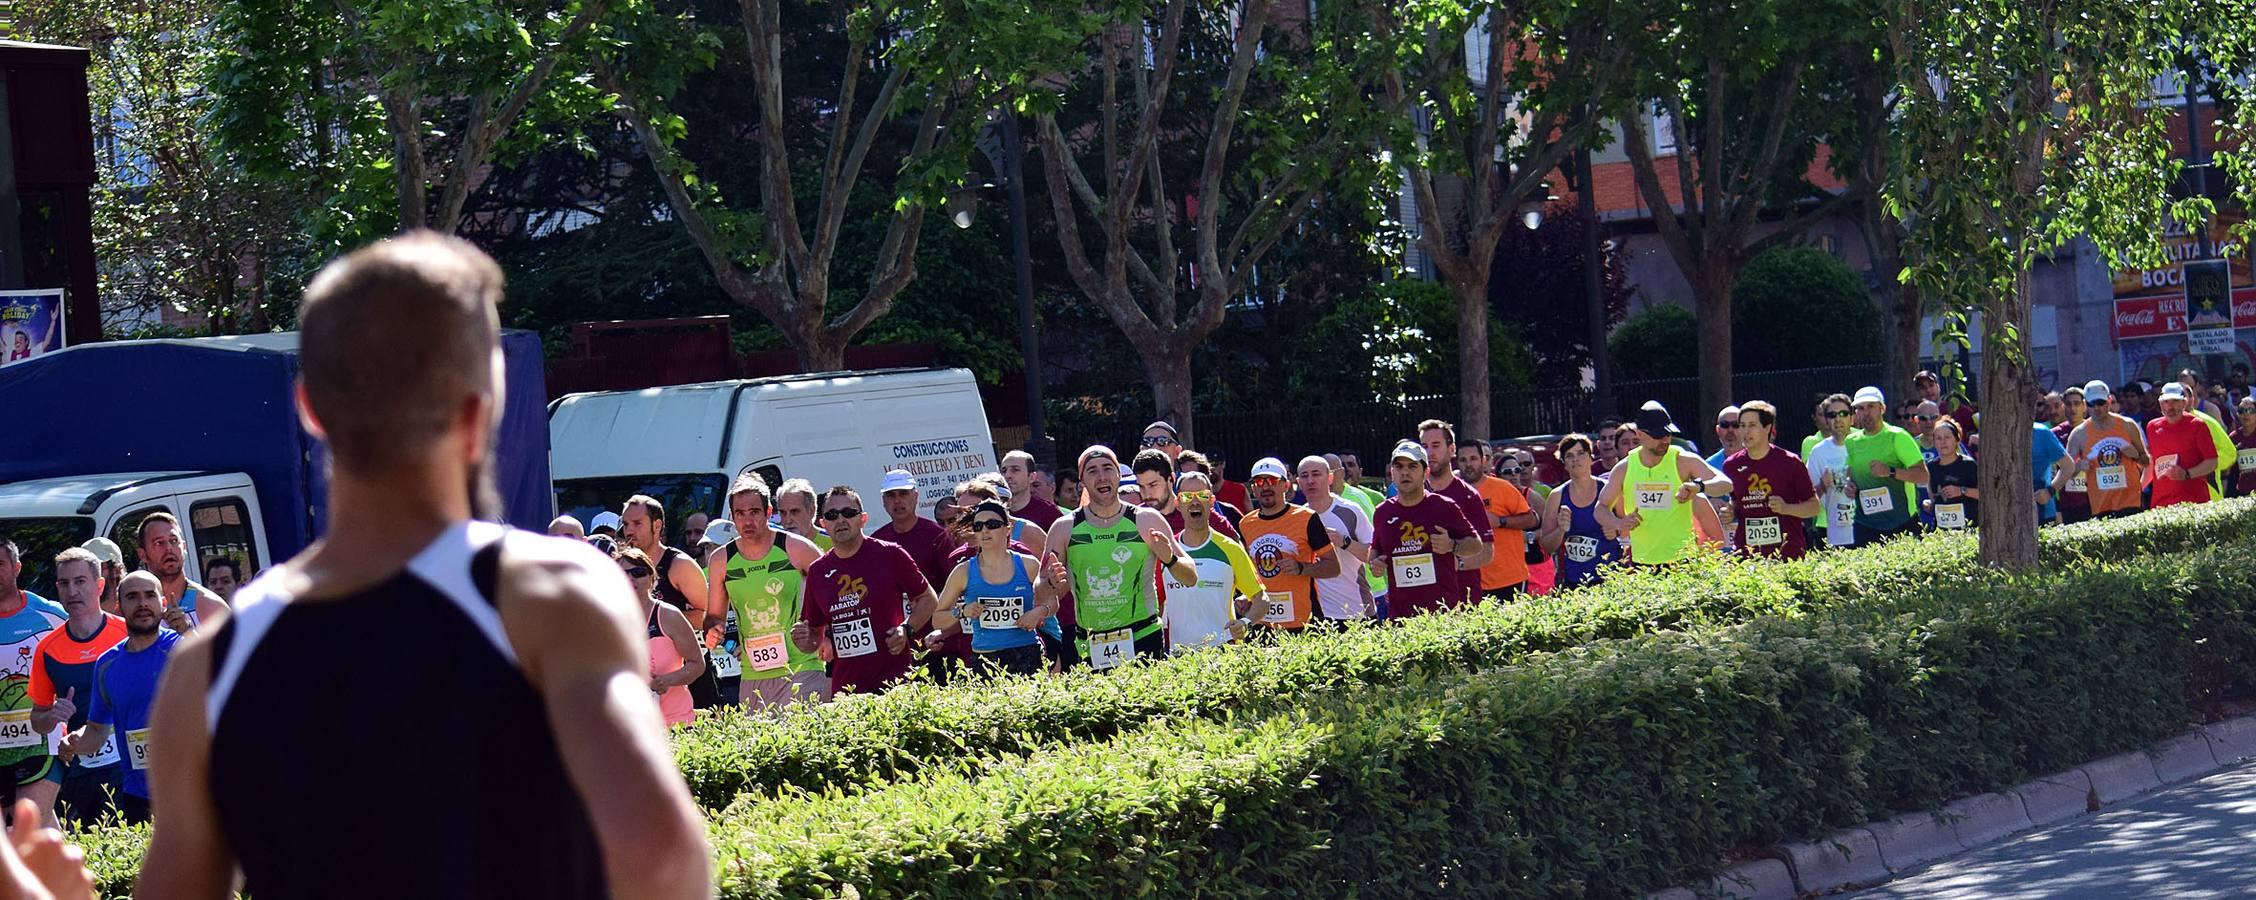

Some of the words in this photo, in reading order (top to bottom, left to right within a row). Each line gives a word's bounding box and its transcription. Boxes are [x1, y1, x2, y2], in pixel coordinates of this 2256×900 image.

[893, 440, 969, 458] CONSTRUCCIONES
[953, 457, 961, 470] Y
[963, 453, 986, 469] BENI
[2102, 474, 2120, 484] 692
[926, 486, 955, 499] LOGROÑO
[1641, 492, 1664, 504] 347
[1864, 497, 1884, 509] 391
[1400, 521, 1429, 547] 25
[1748, 527, 1777, 539] 2059
[1258, 545, 1277, 553] BEER
[1567, 544, 1593, 557] 2162
[1405, 566, 1422, 579] 63
[837, 574, 869, 600] 25
[838, 592, 860, 602] MEDIA
[982, 608, 1020, 622] 2096
[1266, 603, 1285, 615] 56
[835, 631, 871, 651] 2095
[753, 646, 779, 663] 583
[1103, 643, 1119, 658] 44
[1, 723, 30, 738] 494
[87, 740, 114, 758] 23
